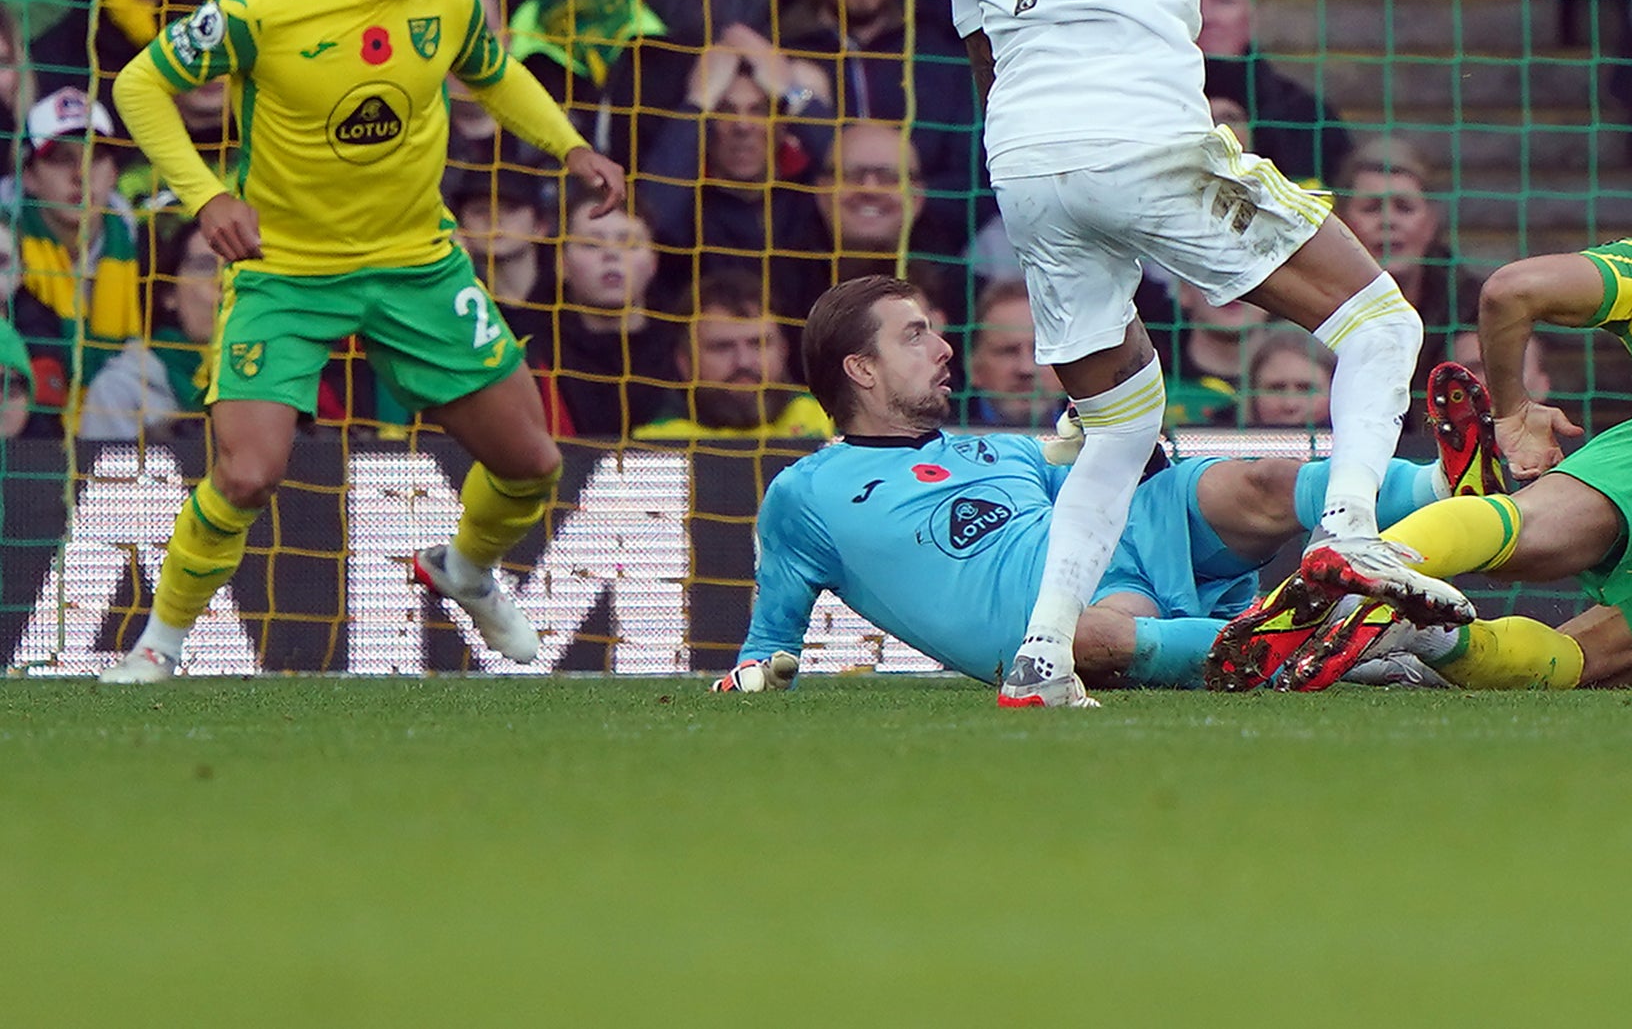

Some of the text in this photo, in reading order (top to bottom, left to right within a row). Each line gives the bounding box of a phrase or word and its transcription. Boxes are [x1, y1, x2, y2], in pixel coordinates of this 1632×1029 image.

[340, 120, 399, 139] LOTUS
[455, 286, 500, 349] 2
[953, 506, 1009, 545] LOTUS
